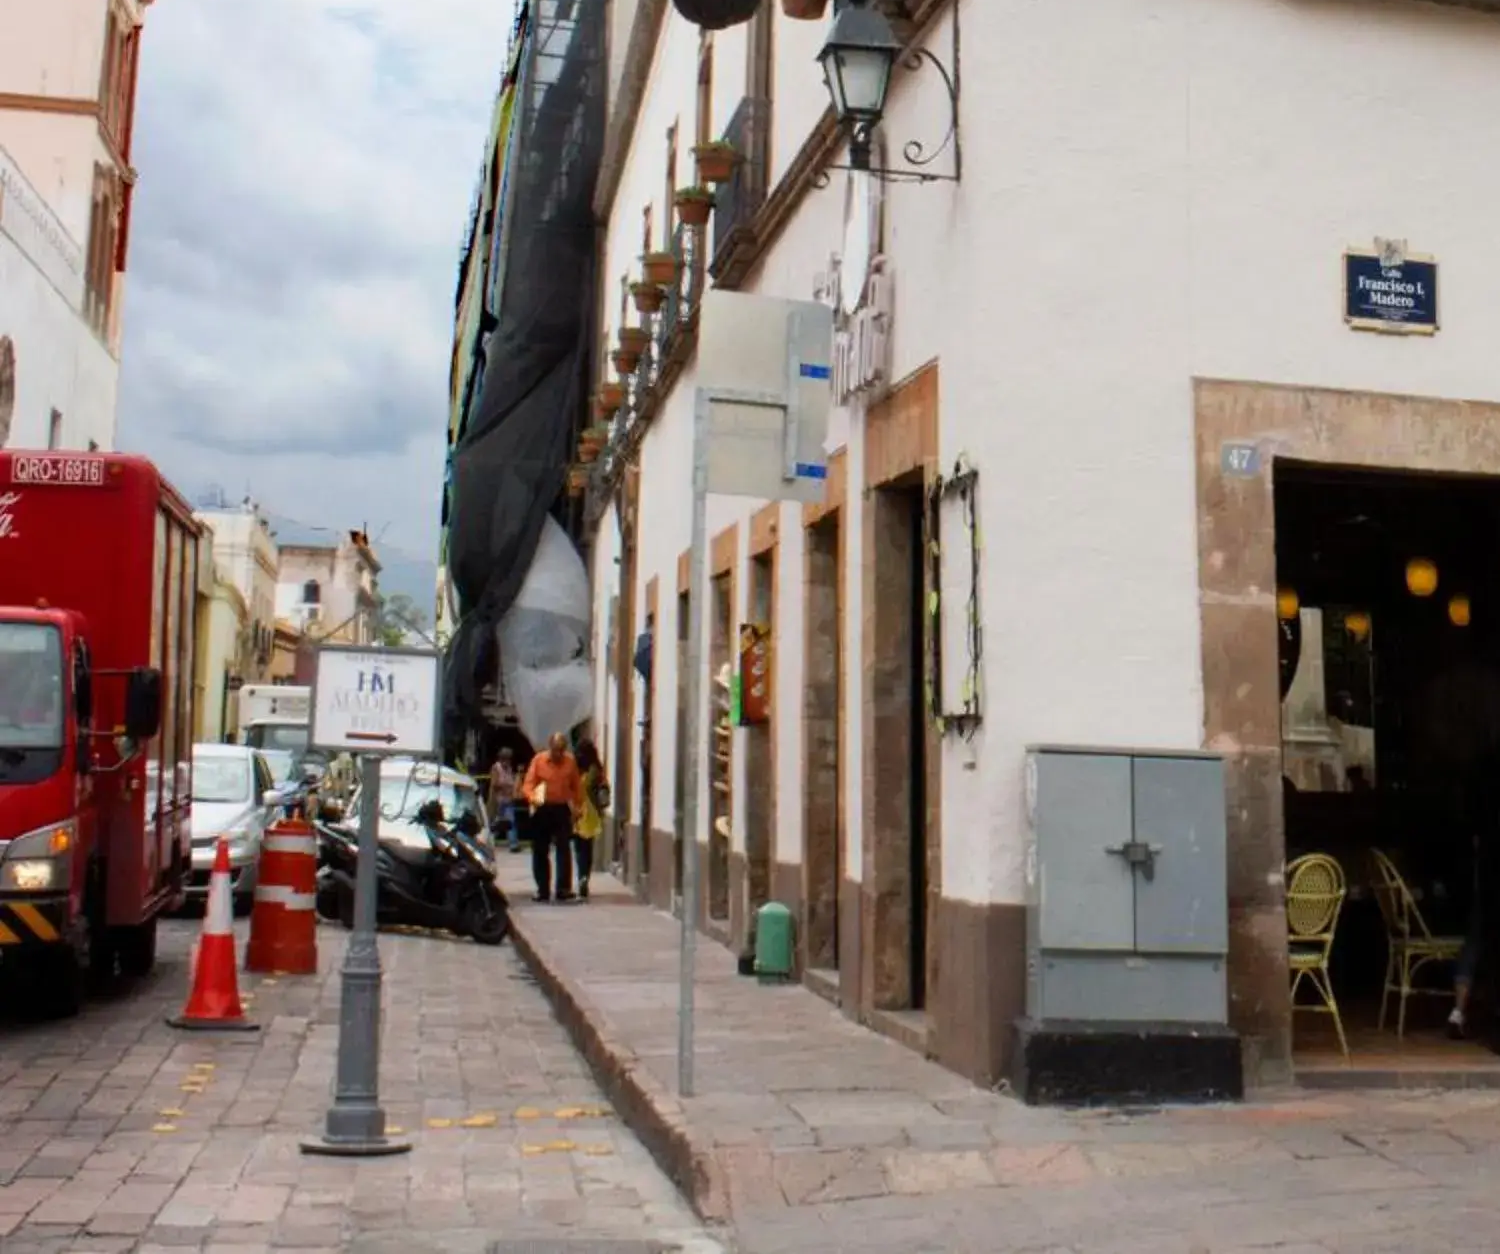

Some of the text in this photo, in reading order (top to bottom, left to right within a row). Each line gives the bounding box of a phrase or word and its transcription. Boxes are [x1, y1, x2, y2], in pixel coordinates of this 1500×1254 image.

[1357, 275, 1415, 294] Francisco
[1371, 291, 1415, 308] Madero
[16, 457, 99, 481] QRO-16916
[1228, 449, 1252, 470] 47
